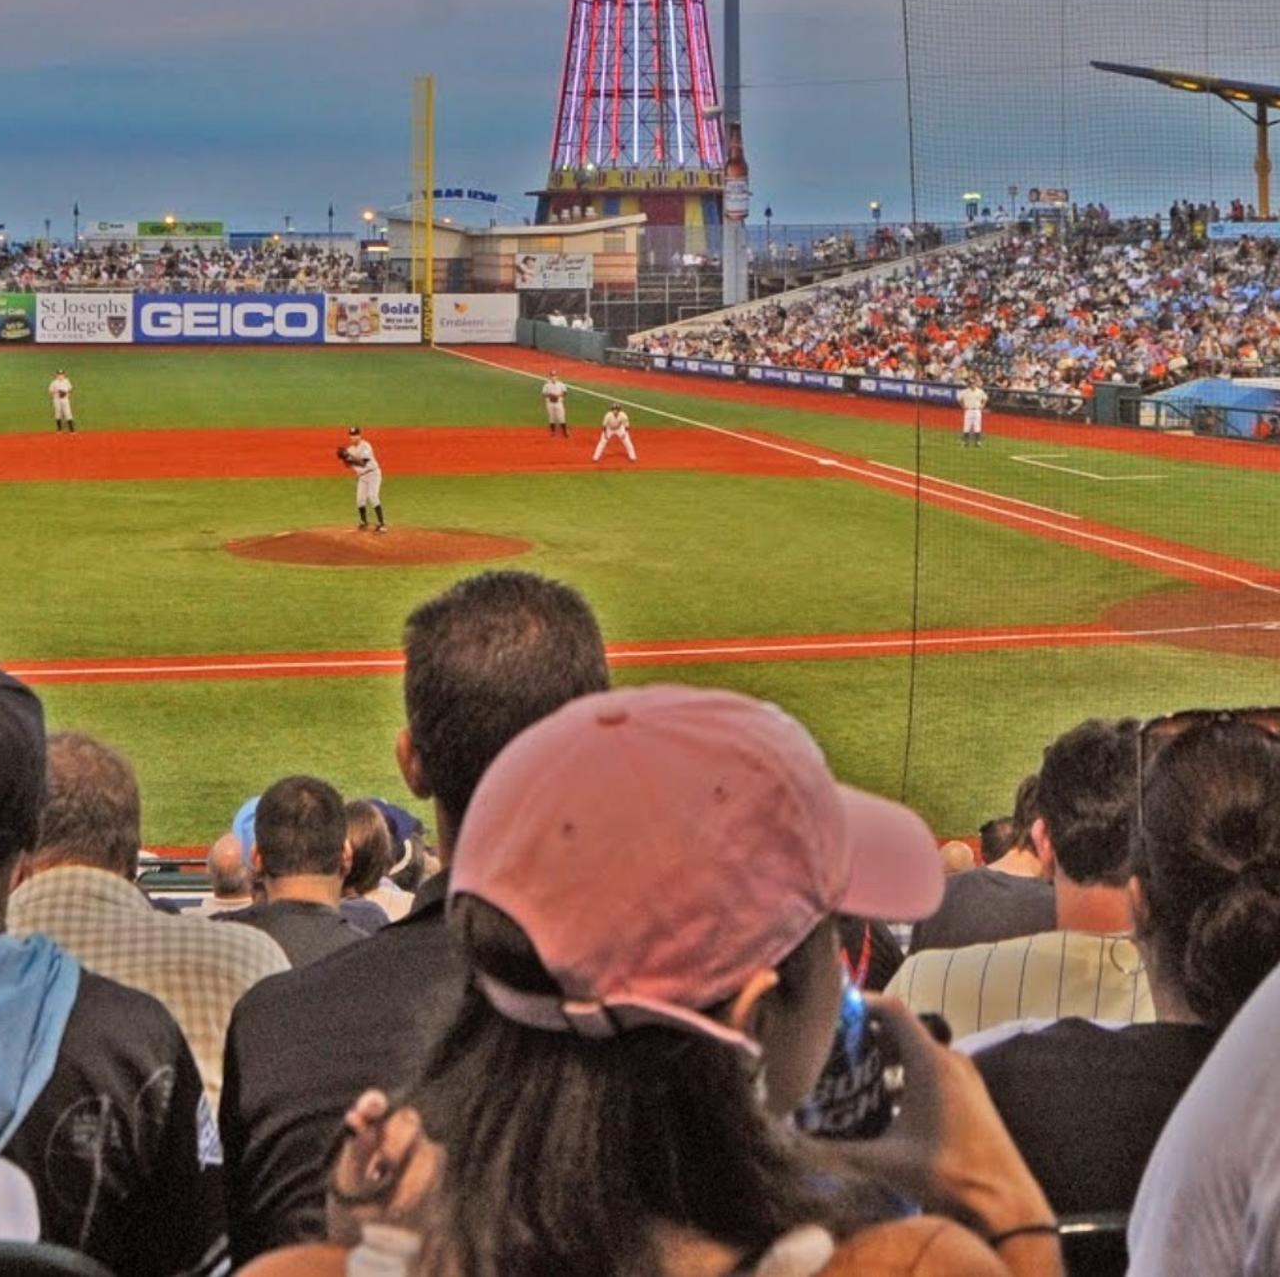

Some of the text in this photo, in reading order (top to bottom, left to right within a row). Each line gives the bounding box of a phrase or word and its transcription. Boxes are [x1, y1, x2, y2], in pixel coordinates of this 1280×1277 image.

[380, 303, 420, 315] Gold's
[40, 316, 106, 337] College
[141, 303, 318, 337] GEICO
